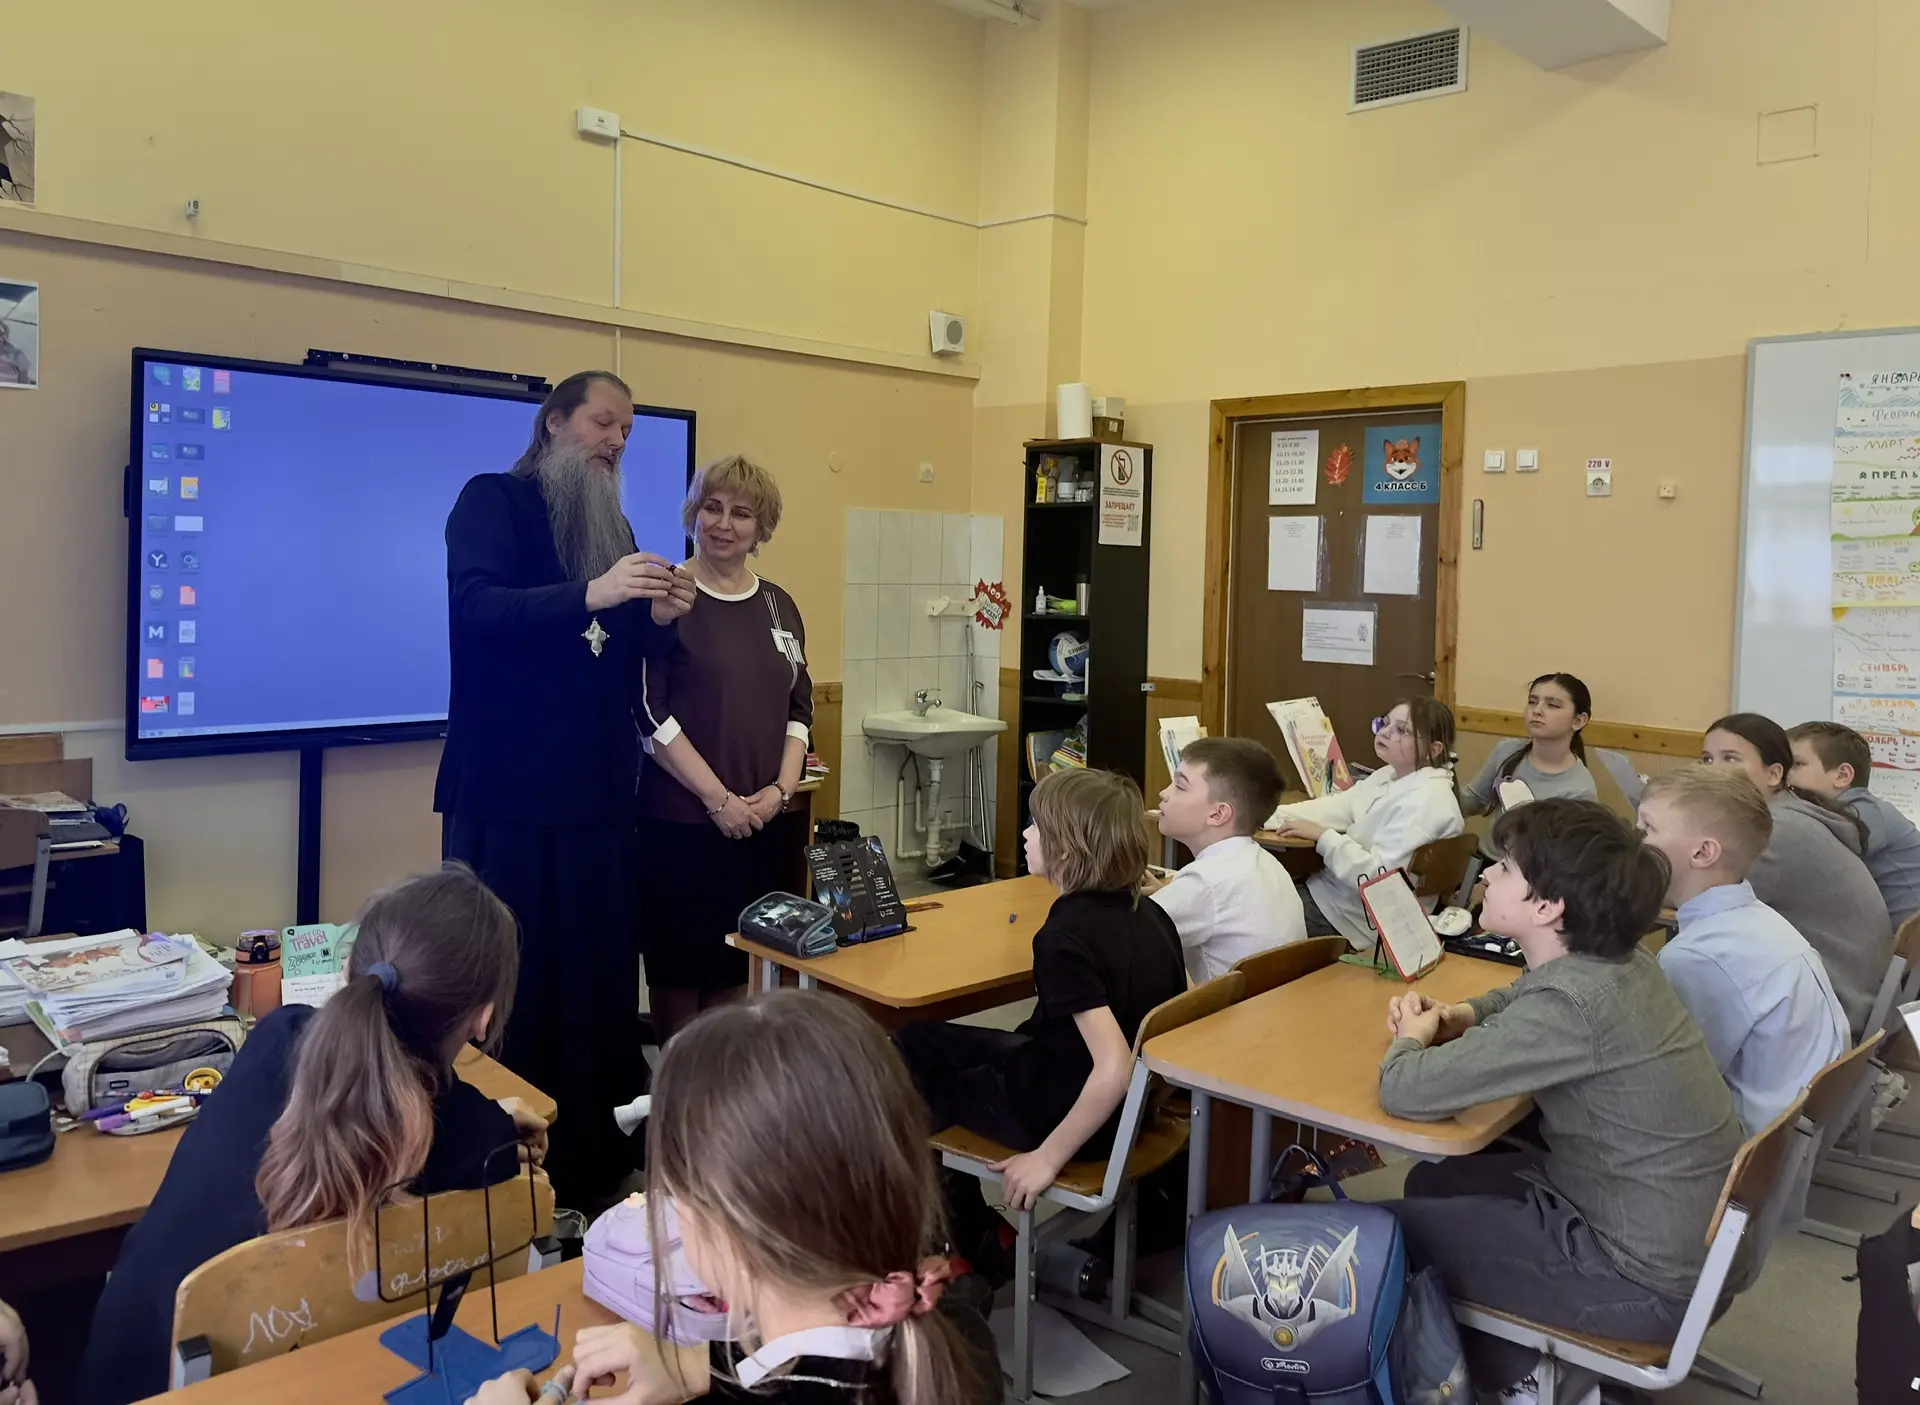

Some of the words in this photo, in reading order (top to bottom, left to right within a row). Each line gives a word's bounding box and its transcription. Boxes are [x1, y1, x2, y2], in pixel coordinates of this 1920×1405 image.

[1864, 439, 1905, 450] МАРТ
[1587, 460, 1602, 469] 220
[1604, 460, 1611, 469] V
[1860, 470, 1918, 480] АПРЕЛЬ
[1374, 482, 1382, 491] 4
[1383, 482, 1418, 491] КЛАСС
[1420, 481, 1427, 491] Б
[1864, 735, 1899, 746] ОЯБРЬ
[289, 930, 328, 952] Travel
